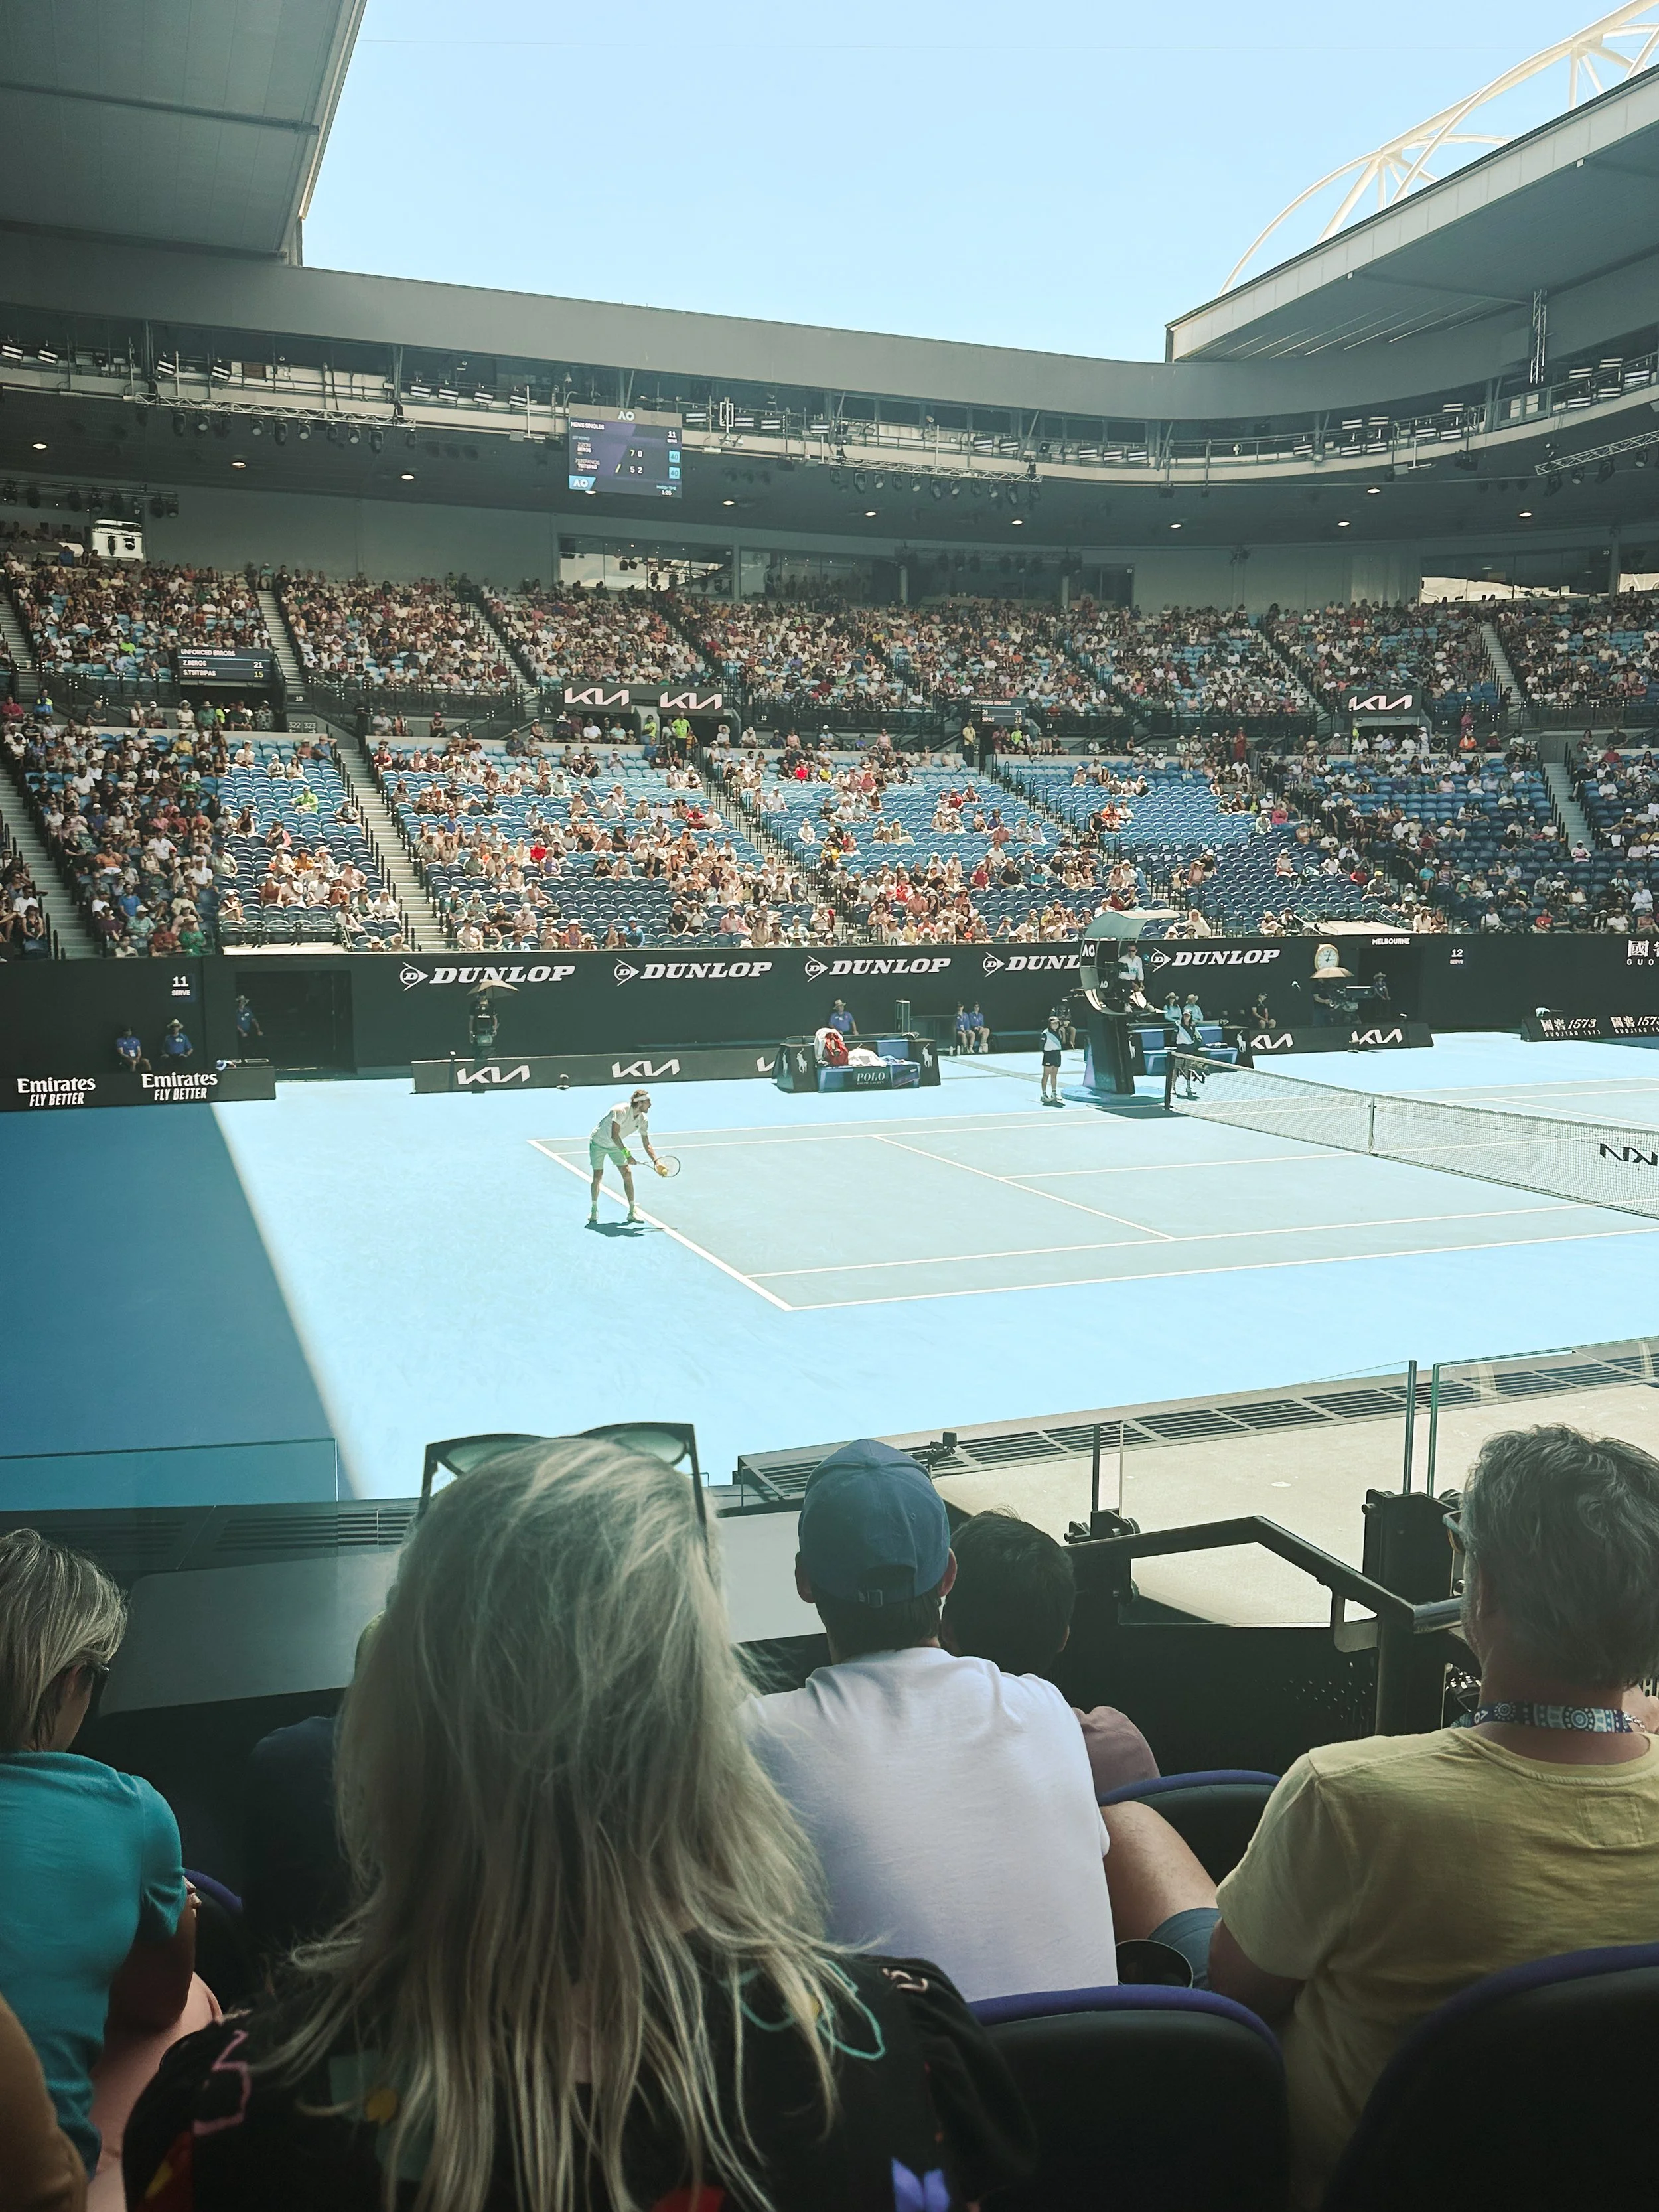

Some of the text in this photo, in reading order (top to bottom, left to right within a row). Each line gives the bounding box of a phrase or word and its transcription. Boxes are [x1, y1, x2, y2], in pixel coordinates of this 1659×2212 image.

[618, 411, 635, 421] AO
[573, 479, 589, 488] AO
[564, 686, 630, 706] KIA
[660, 691, 723, 711] KIA
[1082, 944, 1096, 957] AO
[1171, 949, 1281, 966] DUNLOP
[640, 962, 772, 980] DUNLOP
[829, 958, 951, 975] DUNLOP
[1005, 954, 1080, 971] DUNL
[173, 976, 189, 987] 11
[429, 965, 575, 984] DUNLOP
[1568, 1018, 1597, 1029] 1573
[457, 1065, 531, 1085] KIA
[611, 1059, 680, 1078] KIA
[857, 1072, 885, 1082] POLO
[16, 1076, 96, 1094] Emirates
[141, 1072, 218, 1088] Emirates
[29, 1092, 84, 1107] FLY BETTER
[154, 1087, 208, 1101] FLY BETTER
